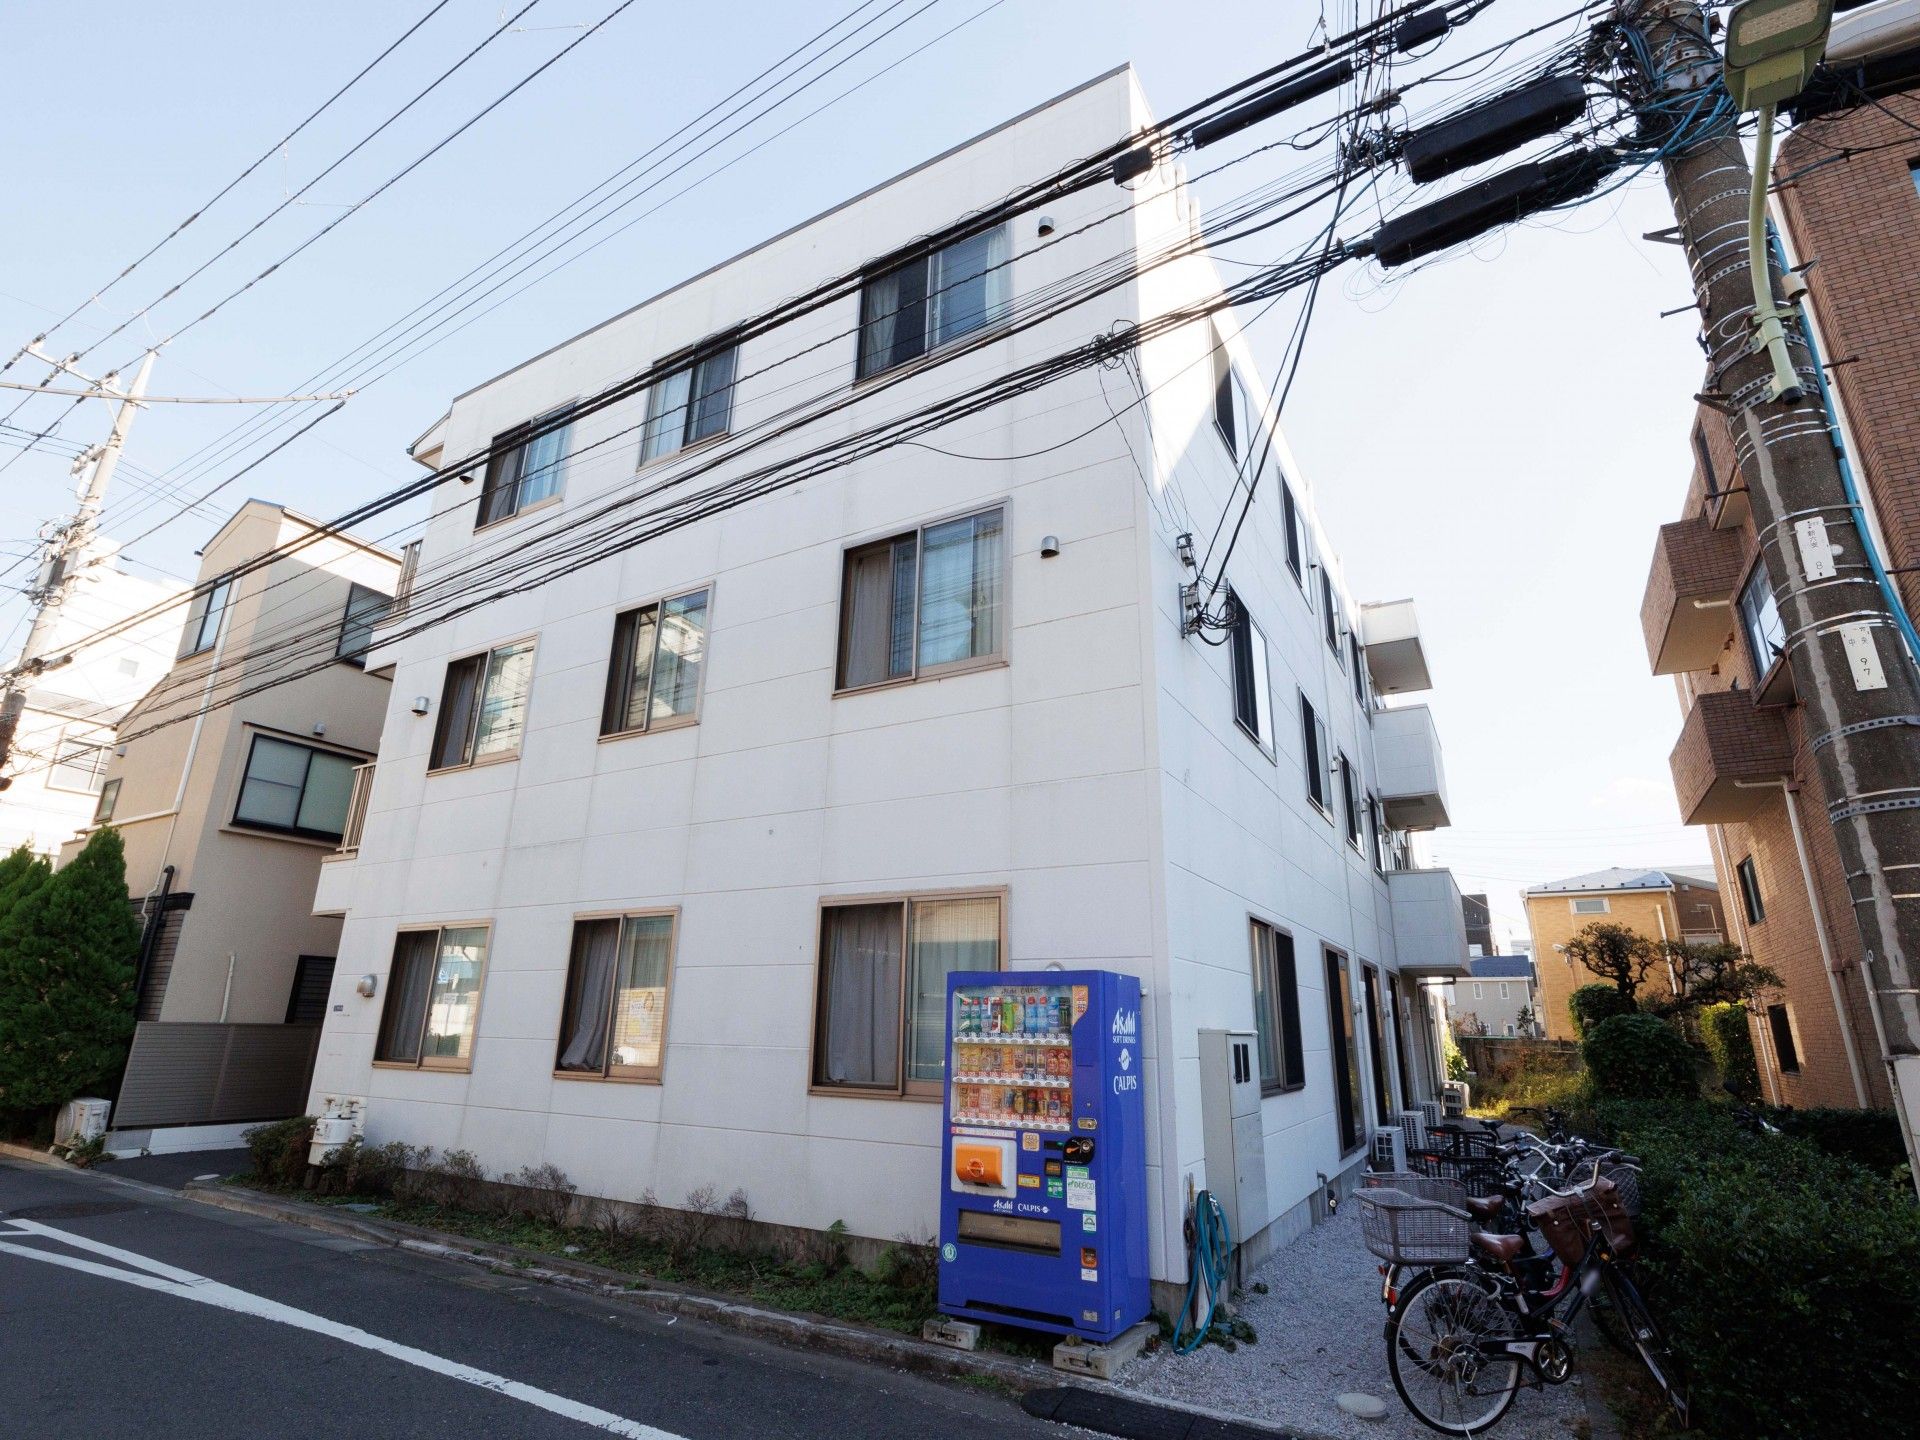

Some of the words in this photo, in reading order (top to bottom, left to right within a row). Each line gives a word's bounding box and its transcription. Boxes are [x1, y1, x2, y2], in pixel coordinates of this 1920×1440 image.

[1860, 658, 1871, 676] 97
[1112, 1008, 1136, 1035] Asahi
[1112, 1035, 1122, 1044] SOFT
[1122, 1036, 1136, 1044] DRINKS
[1113, 1075, 1137, 1095] CALPIS
[993, 1199, 1013, 1210] Asahi
[1017, 1203, 1041, 1213] CALPIS
